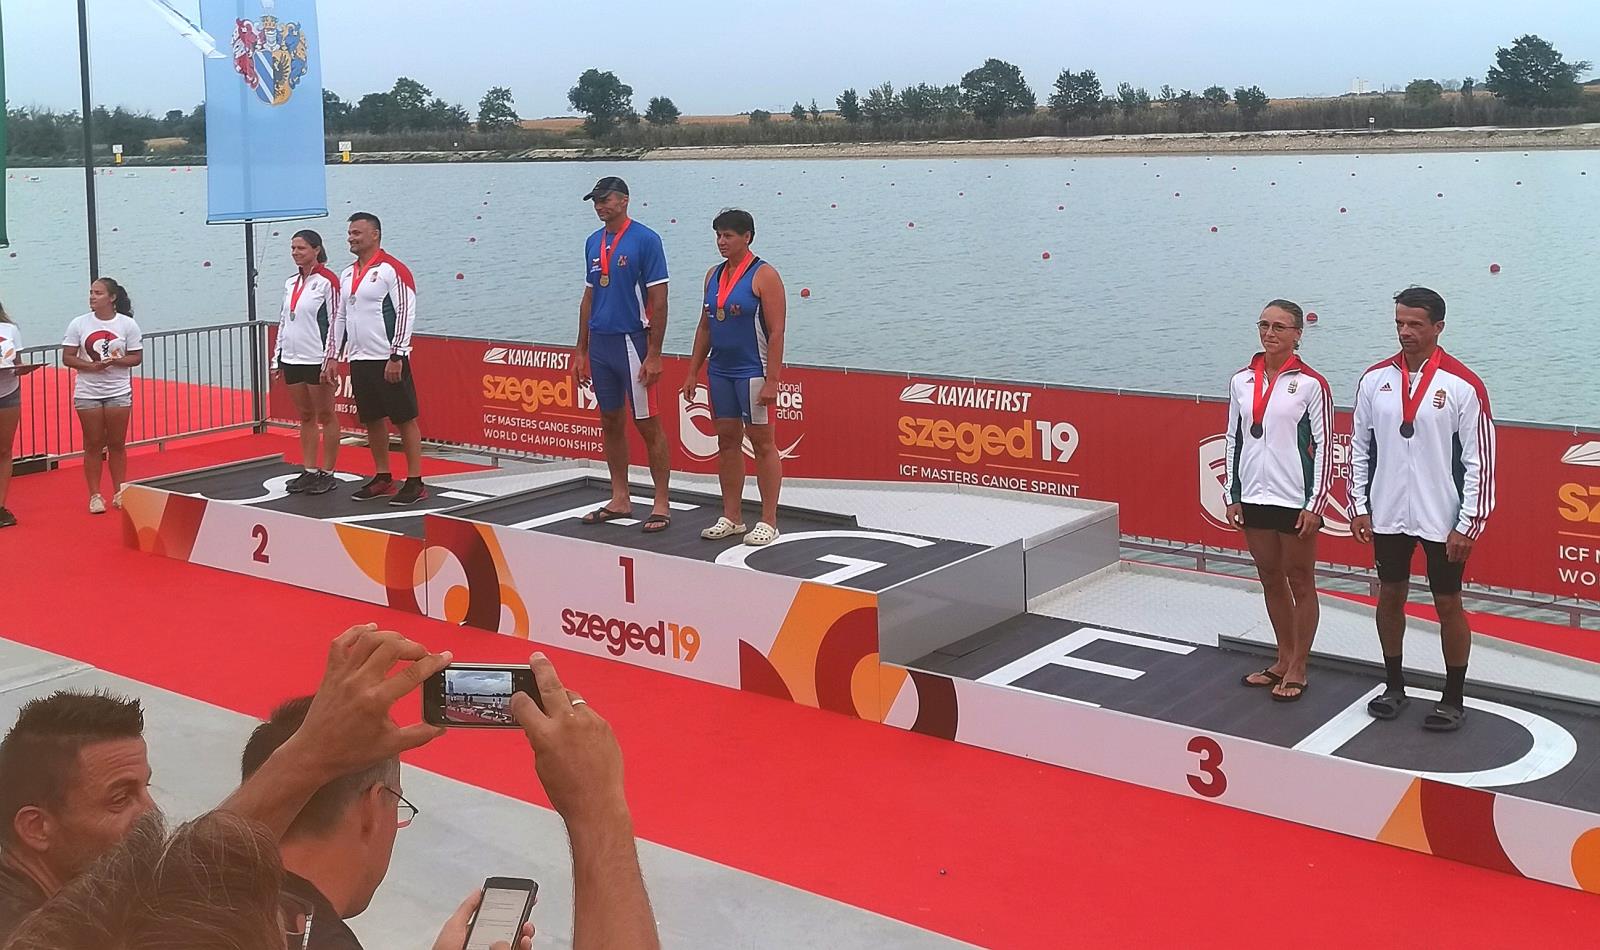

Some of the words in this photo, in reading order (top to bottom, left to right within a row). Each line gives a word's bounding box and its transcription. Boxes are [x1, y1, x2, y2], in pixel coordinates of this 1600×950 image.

[508, 349, 570, 370] KAYAKFIRST
[482, 374, 572, 413] szeged
[777, 381, 802, 393] tional
[937, 385, 1032, 413] KAYAKFIRST
[483, 413, 496, 424] ICF
[498, 415, 537, 429] MASTERS
[539, 420, 569, 433] CANOE
[571, 424, 603, 437] SPRINT
[483, 428, 518, 441] WORLD
[520, 433, 603, 452] CHAMPIONSHIPS
[898, 416, 1033, 464] szeged
[1036, 420, 1079, 463] 19
[899, 464, 918, 477] ICF
[921, 466, 978, 485] MASTERS
[981, 475, 1027, 491] CANOE
[1030, 481, 1080, 497] SPRINT
[251, 523, 270, 564] 2
[1559, 545, 1590, 562] ICF
[618, 555, 635, 604] 1
[561, 608, 666, 657] szeged
[1186, 735, 1228, 798] 3
